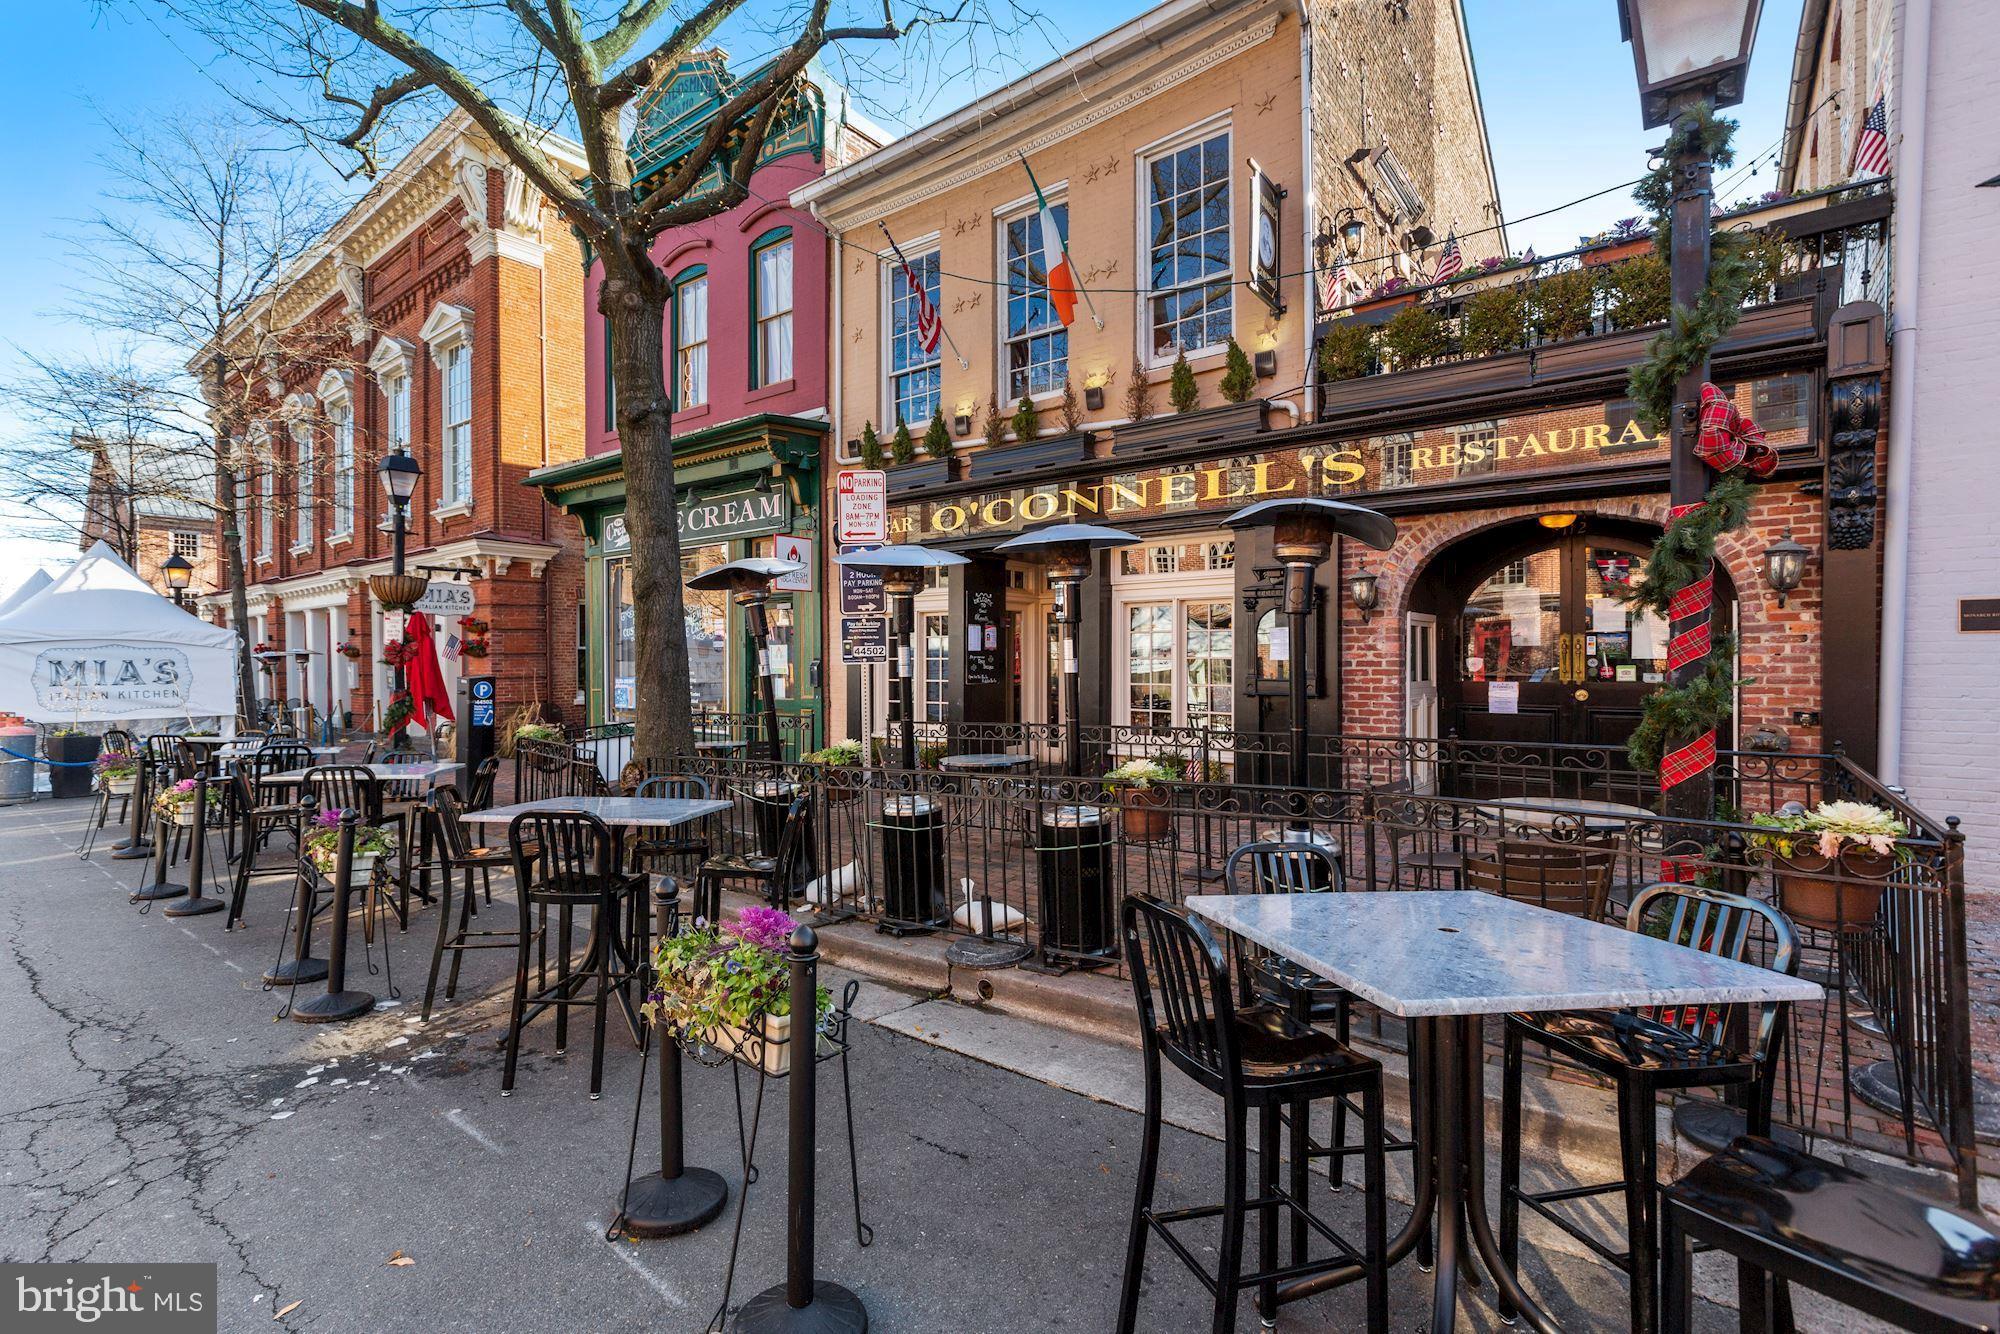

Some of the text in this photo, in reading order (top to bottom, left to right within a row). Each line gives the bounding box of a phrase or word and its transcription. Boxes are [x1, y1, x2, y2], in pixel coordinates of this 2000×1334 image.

[684, 347, 693, 408] YOGA
[932, 449, 1366, 531] O'CONNELL'S
[1409, 420, 1667, 470] RESTAURA
[840, 476, 882, 490] NO PARKING
[688, 493, 782, 531] CREAM
[849, 571, 855, 579] 2
[857, 579, 883, 587] PARKING
[854, 647, 885, 656] 44502
[48, 658, 180, 687] MIA'S
[50, 689, 180, 701] ITALIAN KITCHEN
